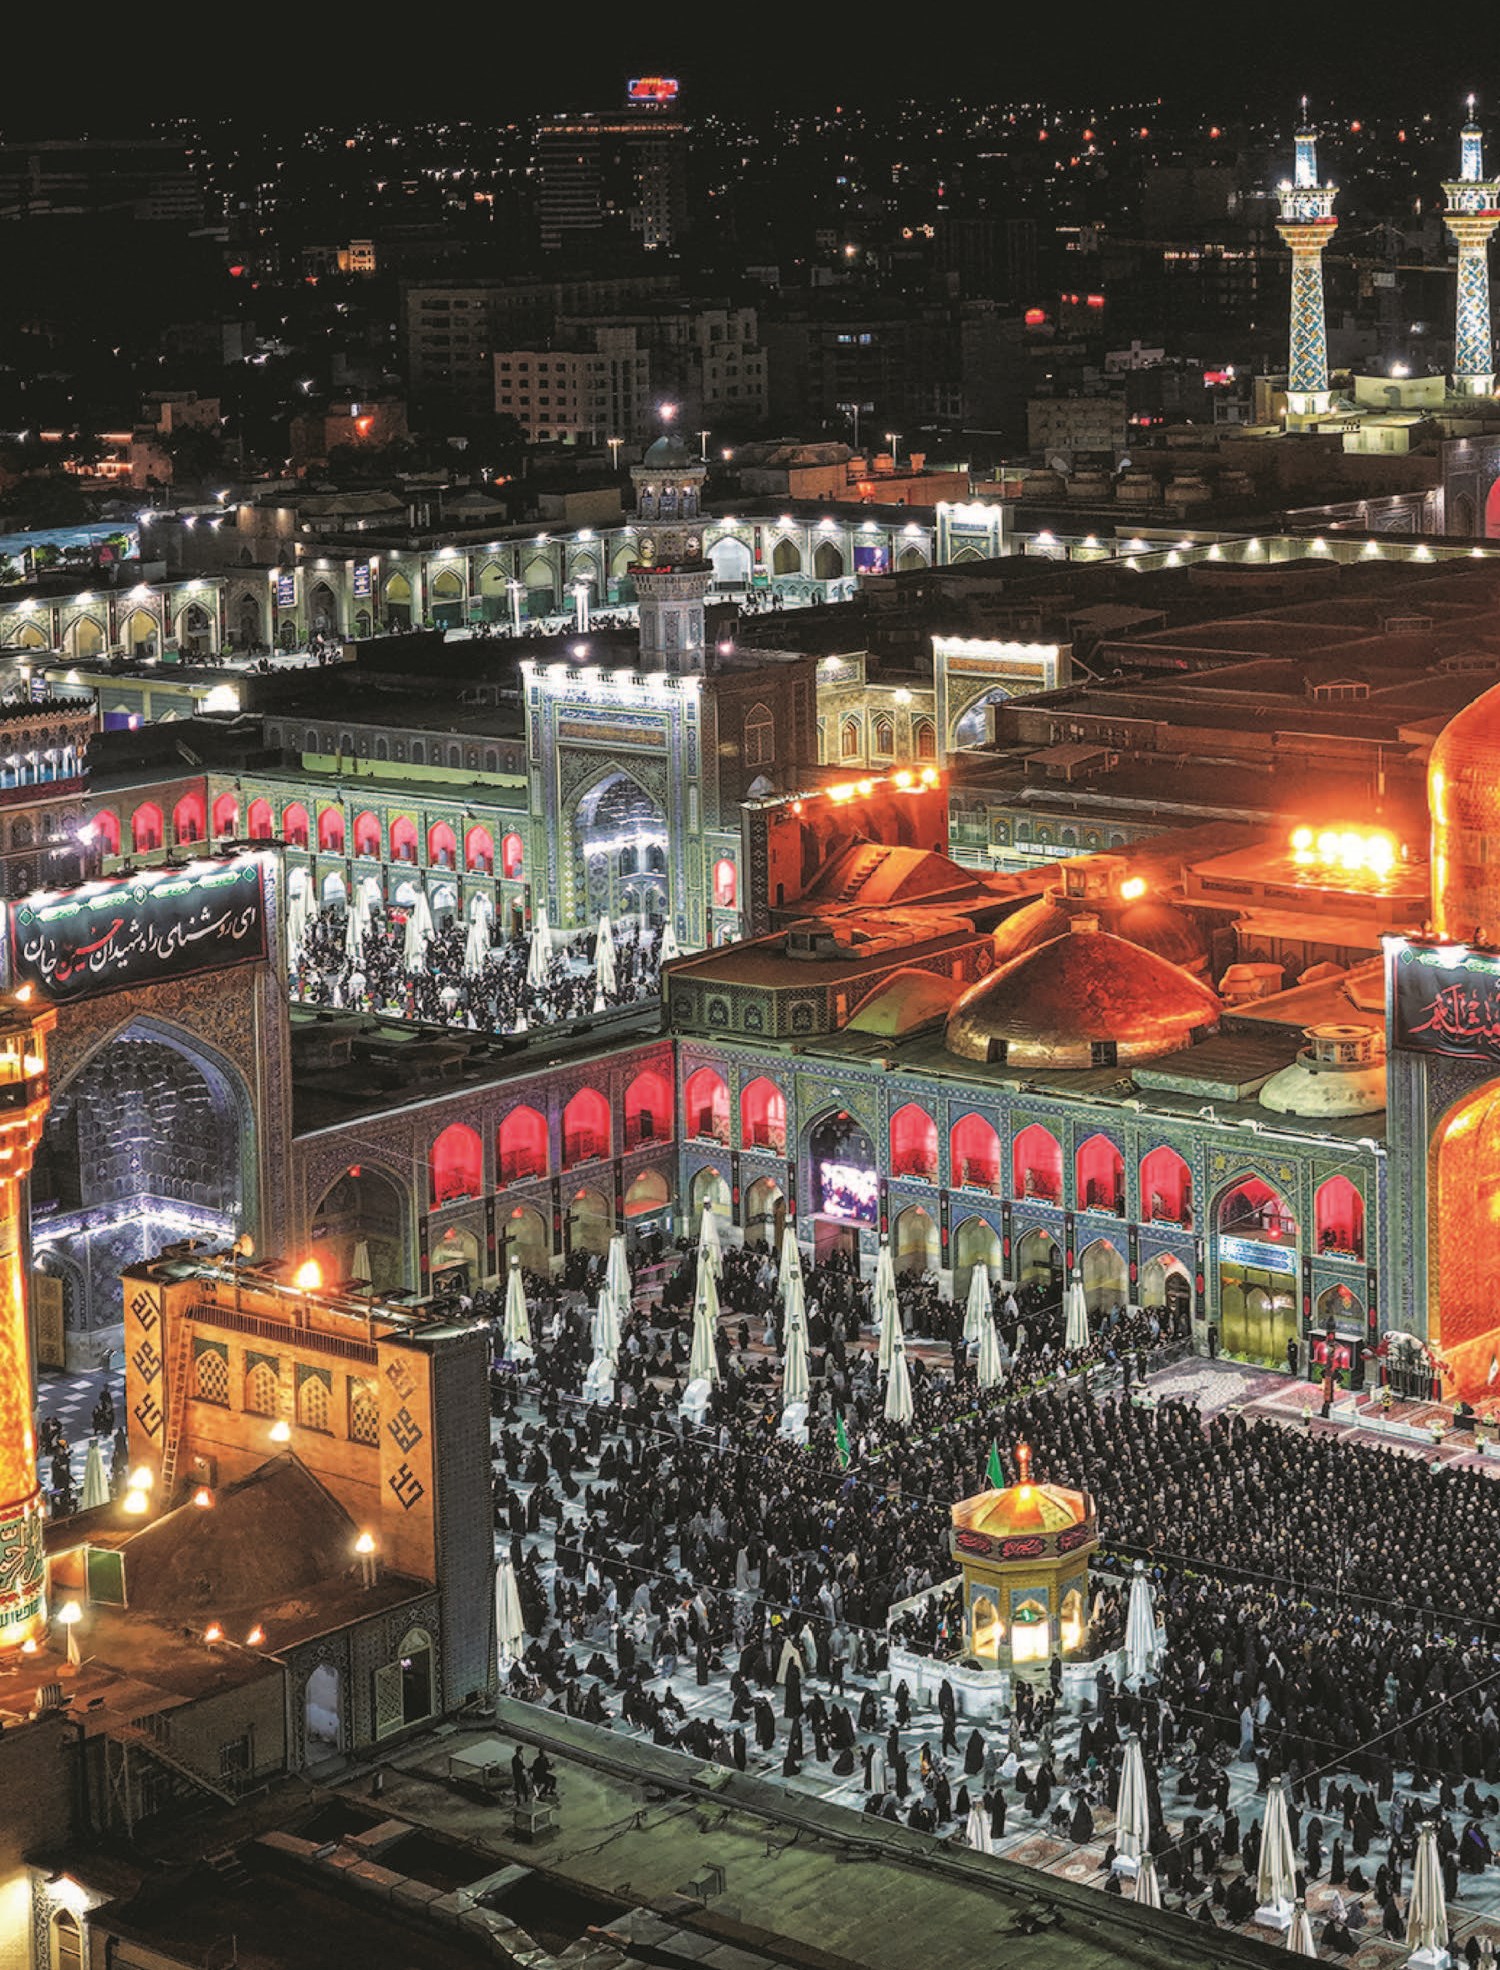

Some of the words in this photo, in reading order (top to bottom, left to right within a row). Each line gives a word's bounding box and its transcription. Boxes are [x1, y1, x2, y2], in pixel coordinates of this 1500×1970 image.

[89, 919, 143, 972] شهیدان
[139, 923, 158, 952] راه
[232, 906, 256, 939] ای
[24, 934, 57, 983] جان
[54, 918, 124, 980] حسین
